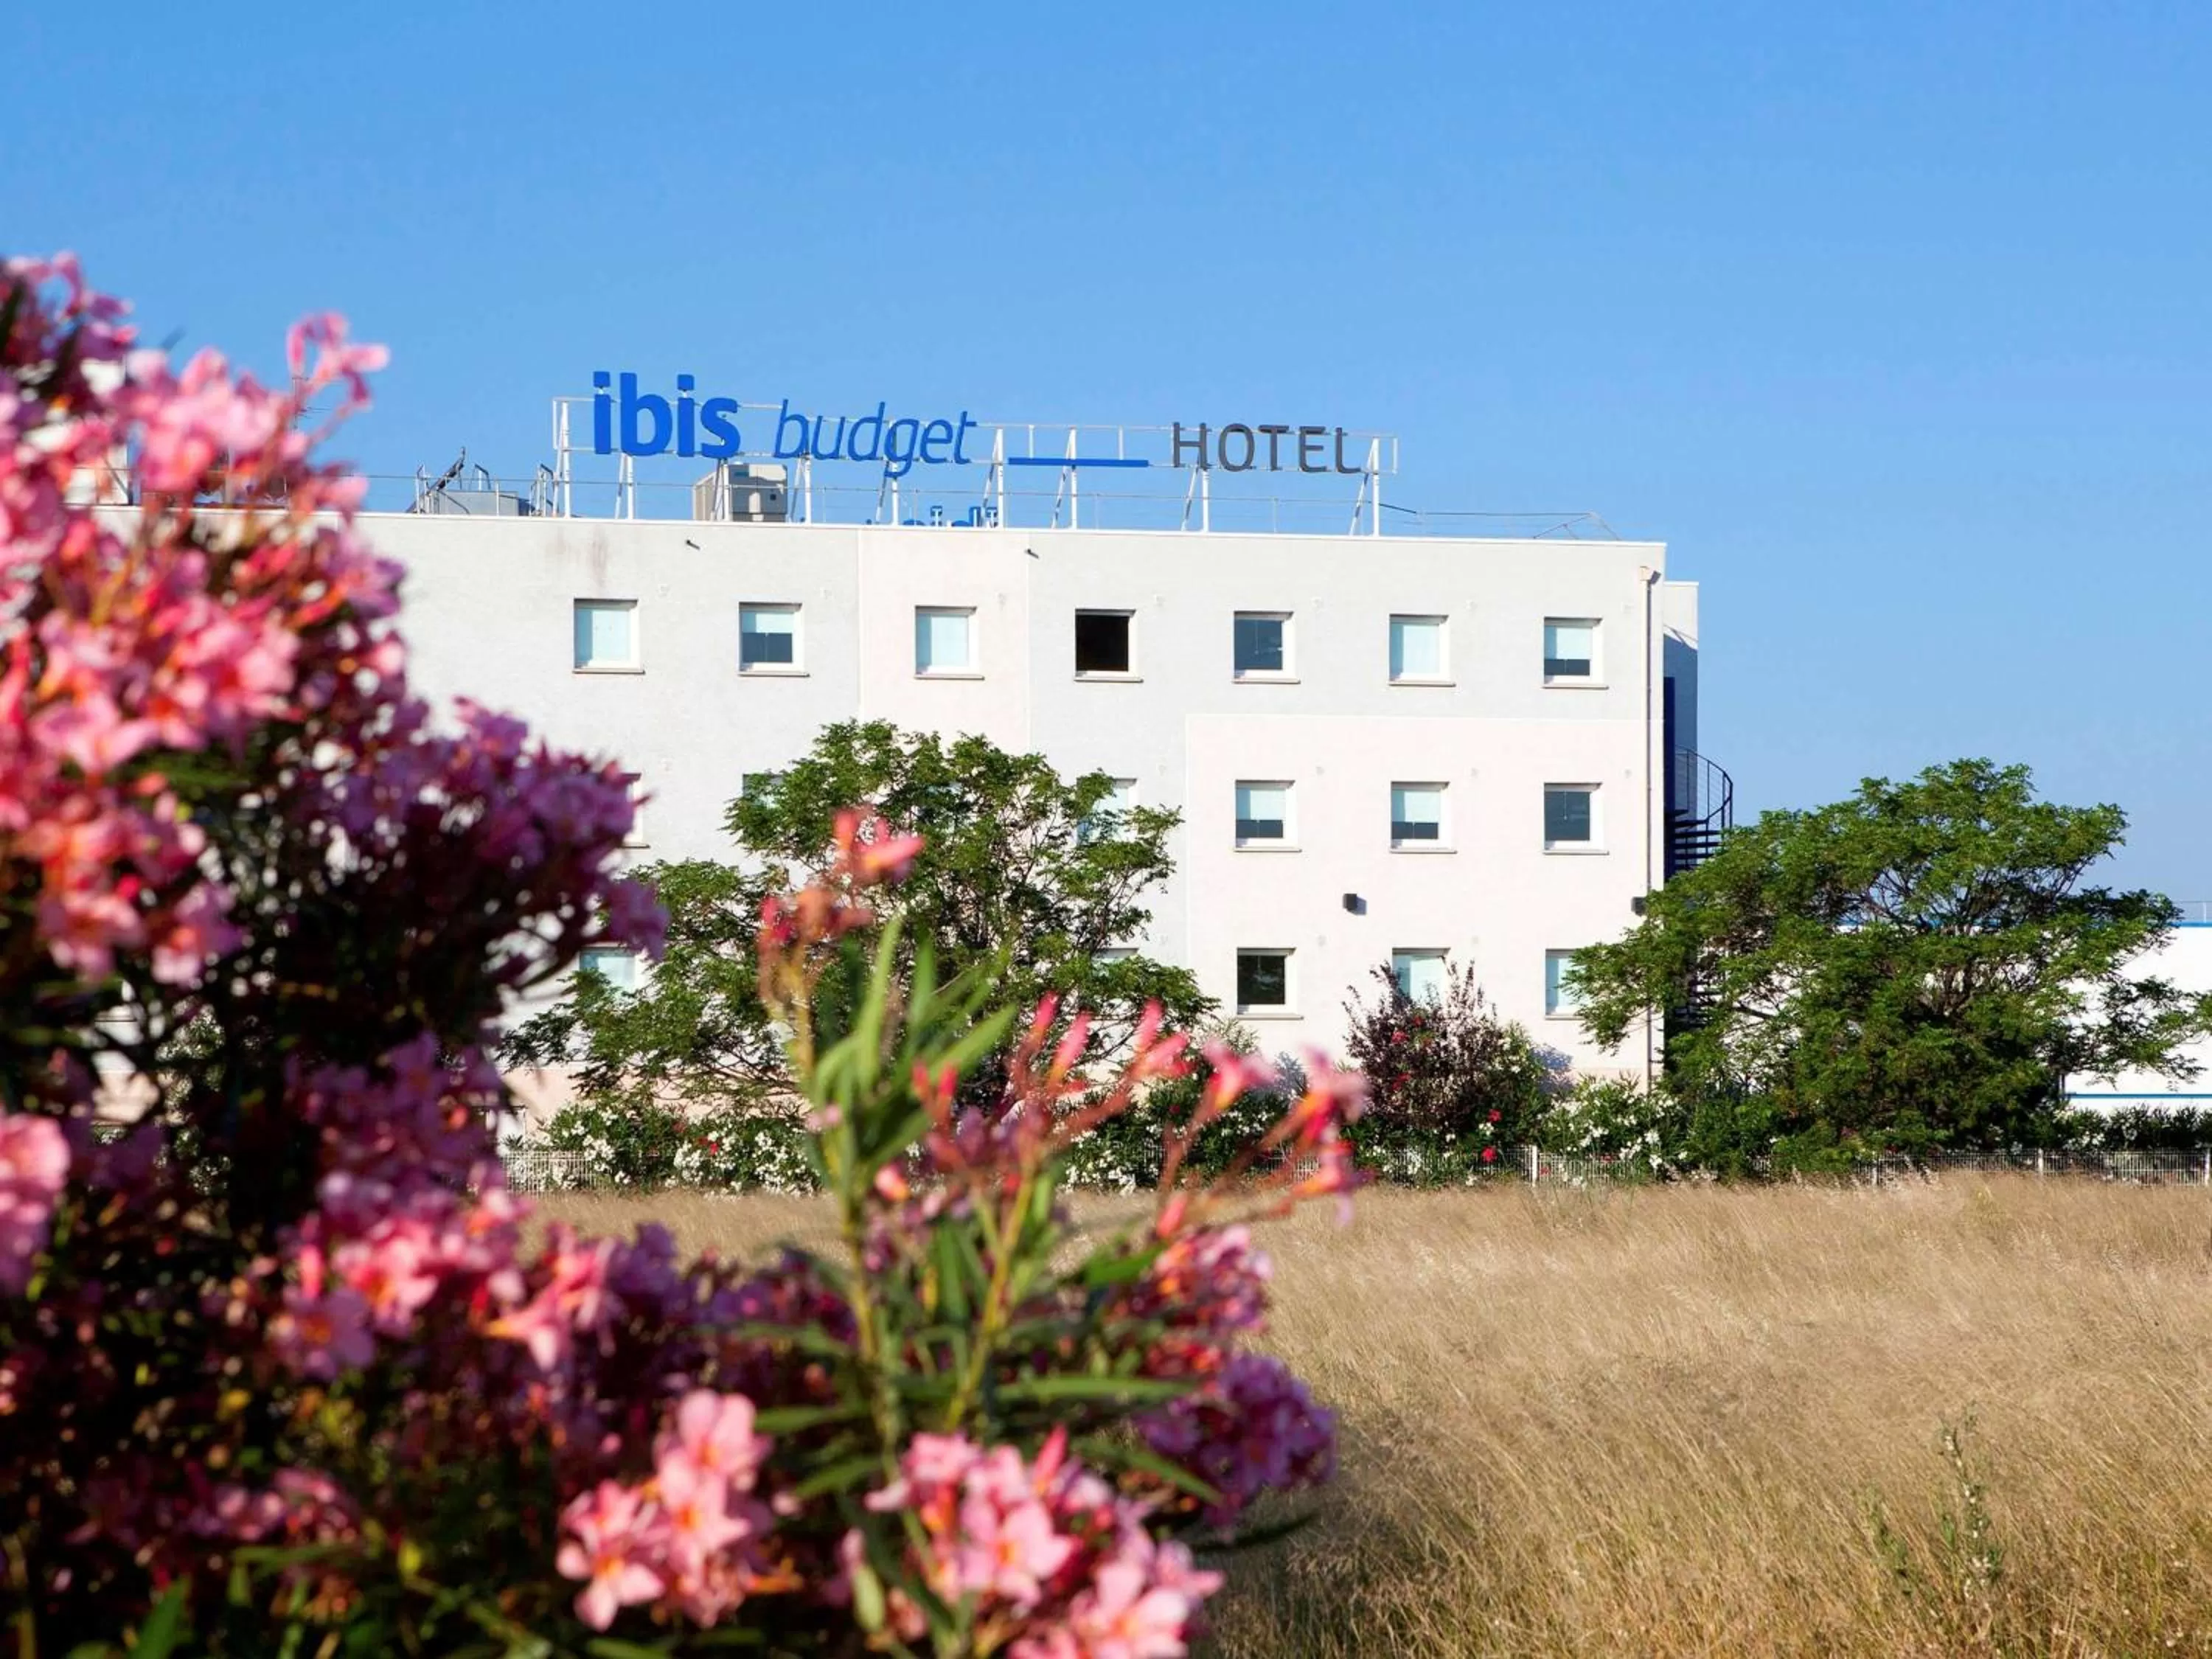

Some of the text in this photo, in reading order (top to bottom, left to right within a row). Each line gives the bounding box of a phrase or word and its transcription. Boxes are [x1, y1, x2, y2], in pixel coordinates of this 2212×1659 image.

[594, 372, 1360, 477] ibis budget HOTEL
